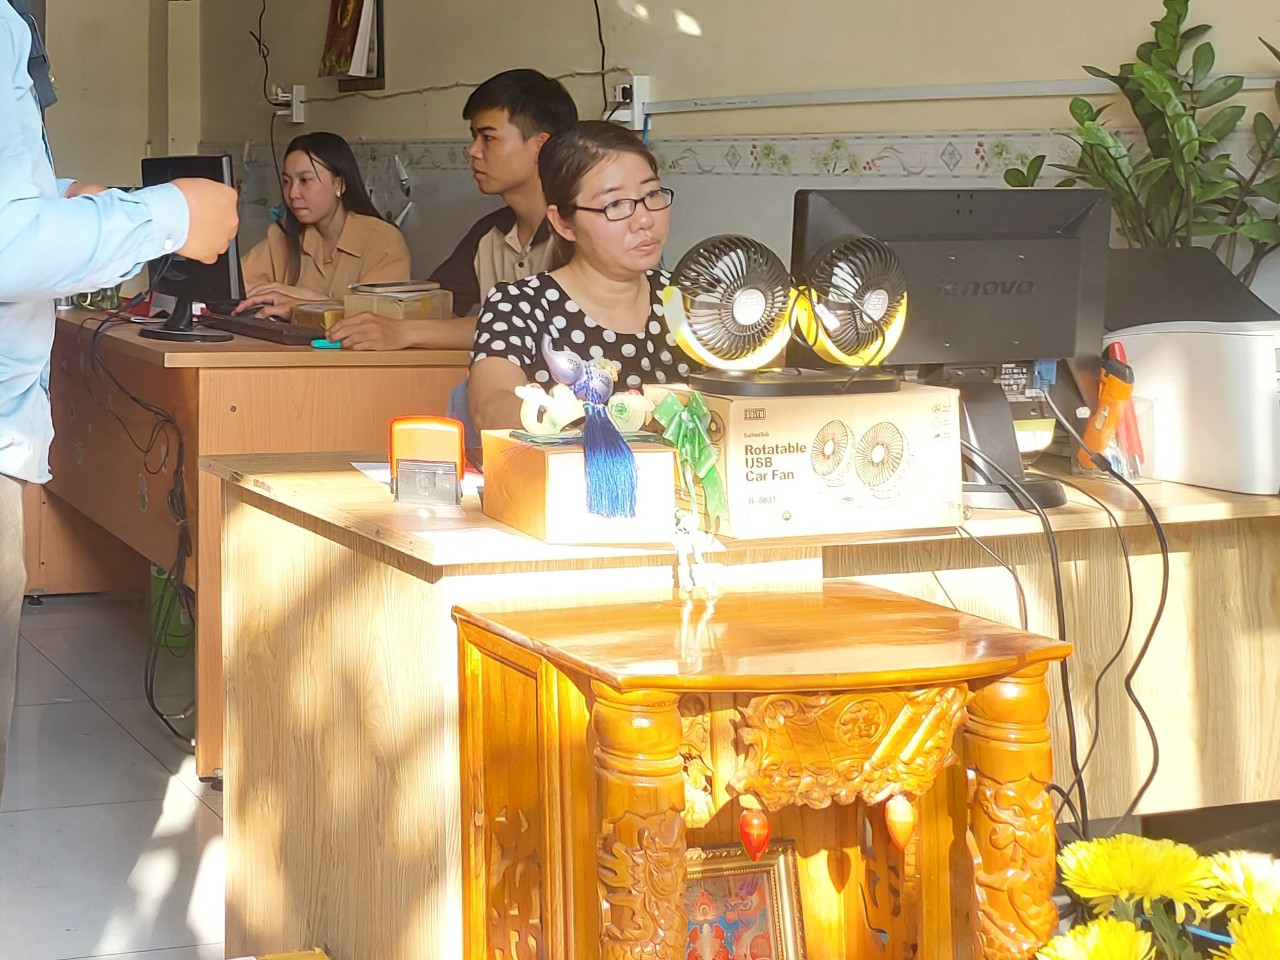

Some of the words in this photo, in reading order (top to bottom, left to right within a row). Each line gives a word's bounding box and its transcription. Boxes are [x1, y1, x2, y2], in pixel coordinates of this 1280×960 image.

[745, 442, 807, 456] Rotatable
[745, 456, 773, 469] USB
[745, 470, 768, 482] Car
[771, 469, 795, 481] Fan
